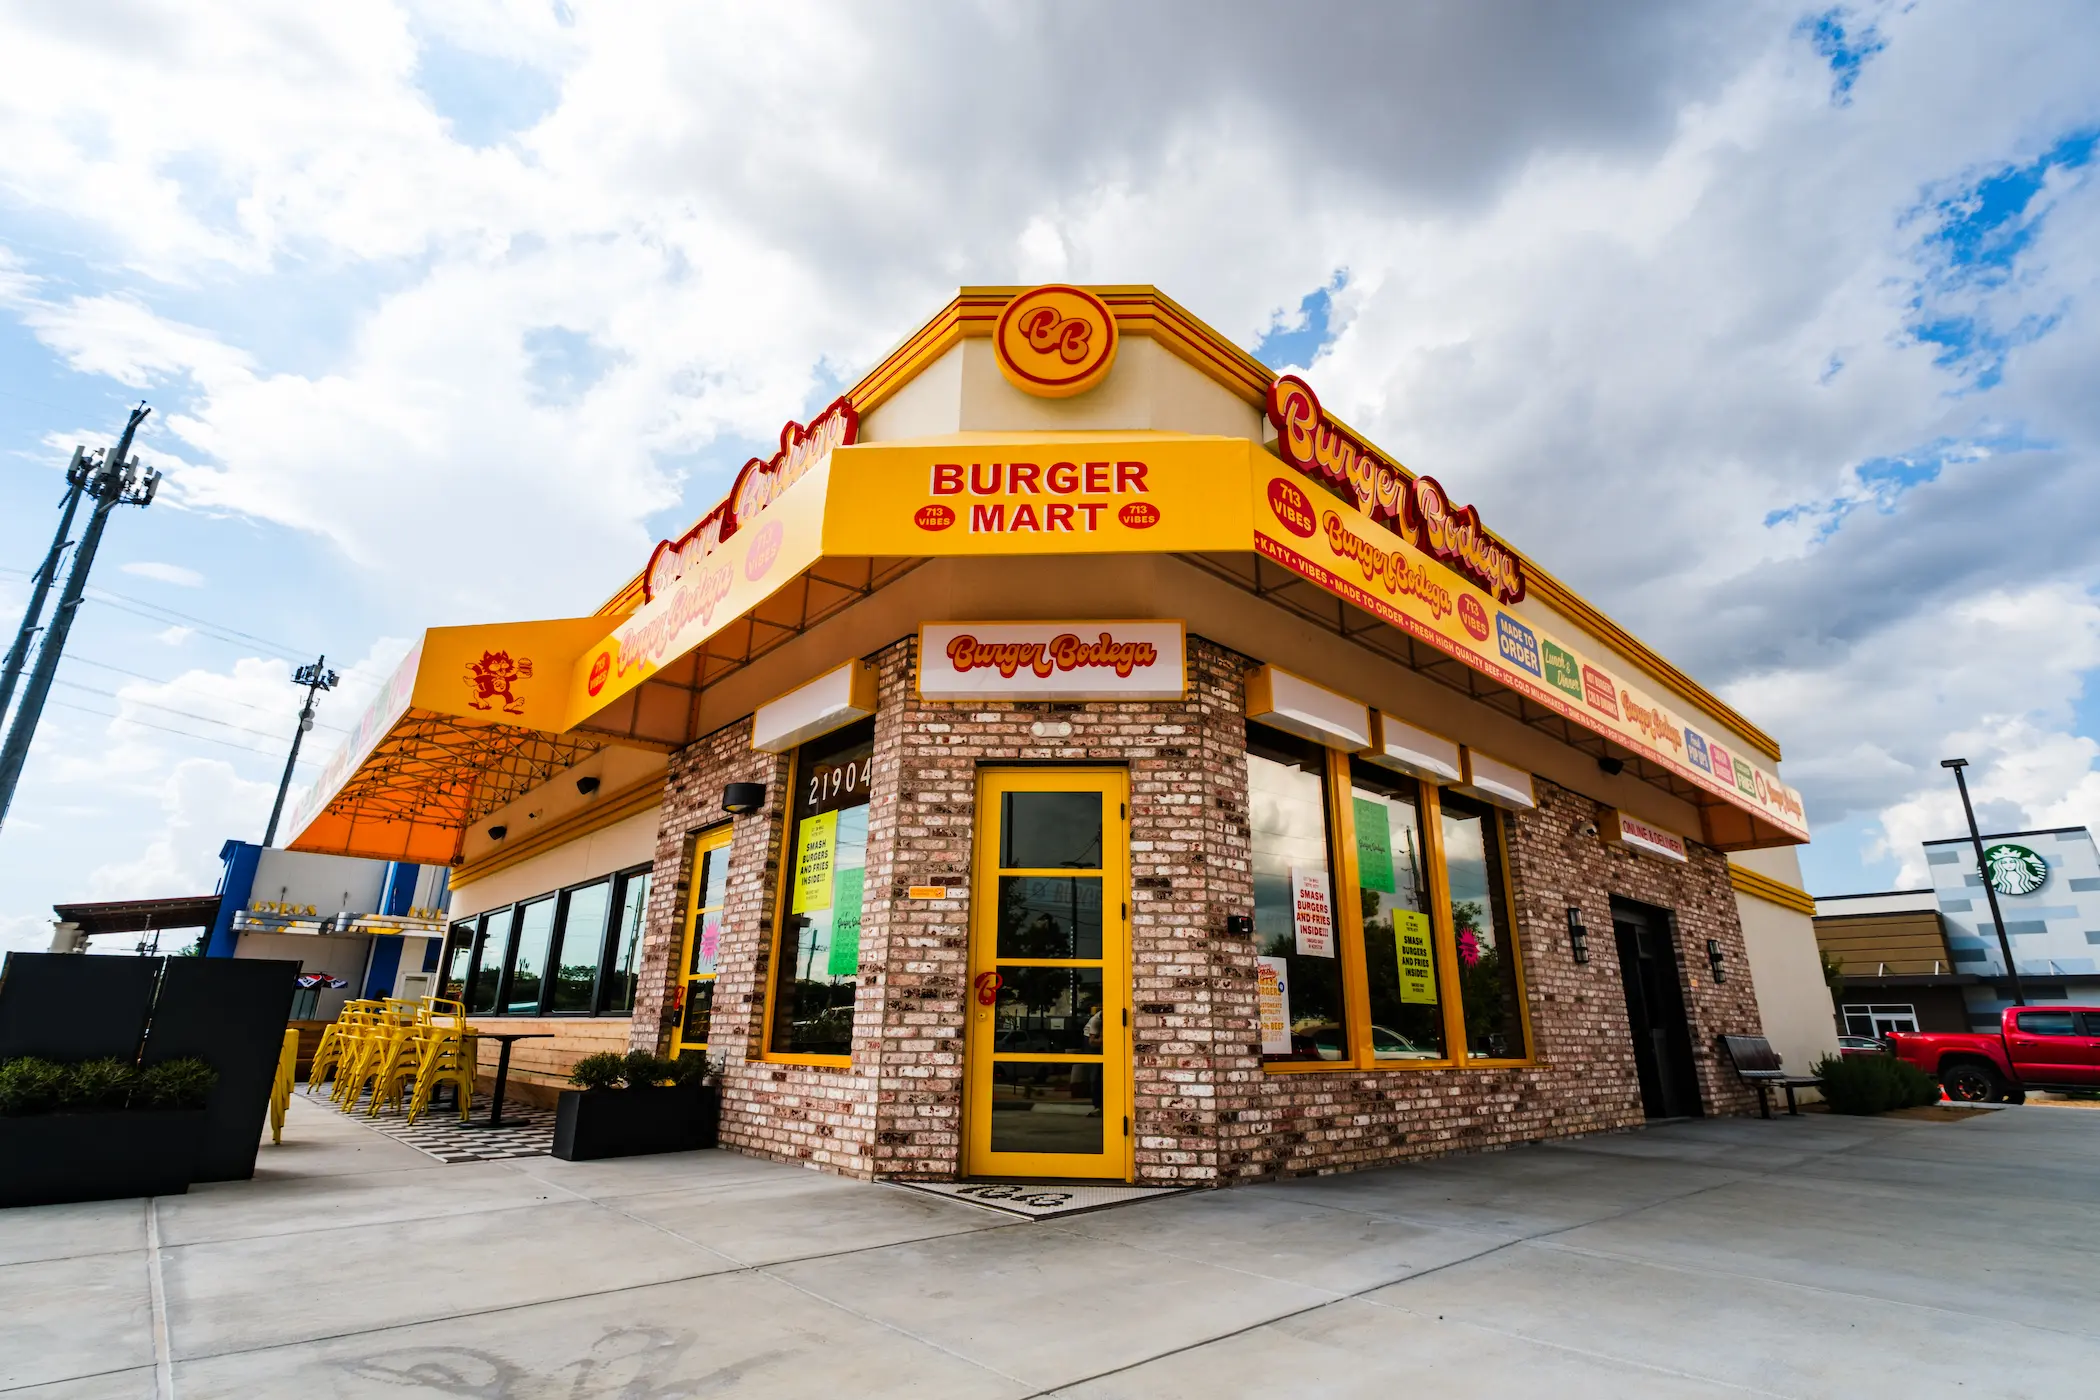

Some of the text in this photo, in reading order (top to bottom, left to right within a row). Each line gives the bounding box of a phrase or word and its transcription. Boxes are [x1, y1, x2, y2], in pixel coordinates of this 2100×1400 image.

[1018, 306, 1092, 365] BB
[929, 461, 1150, 497] BURGER
[1272, 378, 1521, 601] Burger Bodega
[1279, 482, 1302, 508] 713
[925, 507, 944, 517] 713
[968, 502, 1109, 534] MART
[1129, 505, 1148, 514] 713
[1273, 497, 1312, 532] VIBES
[918, 517, 951, 526] VIBES
[1122, 515, 1155, 524] VIBES
[1322, 509, 1452, 621] Burger Bodega
[1260, 538, 1291, 565] KATY
[1298, 558, 1328, 584] VIBES
[1334, 579, 1361, 603] MADE
[1363, 595, 1375, 609] TO
[1376, 602, 1404, 626] ORDER
[1409, 620, 1435, 643] FRESH
[1436, 634, 1454, 652] HIGH
[1455, 646, 1483, 668] QUALITY
[1484, 662, 1500, 678] BEEF
[1503, 672, 1513, 685] ICE
[1514, 678, 1530, 693] COLD
[1464, 597, 1479, 616] 713
[1461, 611, 1487, 636] VIBES
[1500, 618, 1534, 649] MADE TO
[946, 632, 1157, 679] Burger Bodega
[1500, 633, 1539, 672] ORDER
[808, 757, 872, 806] 21904
[806, 839, 827, 852] SMASH
[1622, 820, 1648, 841] ONLINE
[1653, 832, 1684, 857] DELIVERY
[802, 850, 828, 864] BURGERS
[800, 861, 829, 875] AND FRIES
[801, 873, 826, 886] INSIDE!!!
[1300, 889, 1324, 901] SMASH
[1297, 900, 1328, 914] BURGERS
[1296, 912, 1331, 926] AND FRIES
[1300, 924, 1329, 937] INSIDE!!!
[1404, 935, 1423, 946] SMASH
[1402, 945, 1427, 957] BURGERS
[1402, 956, 1429, 968] AND FRIES
[974, 971, 1003, 1006] B
